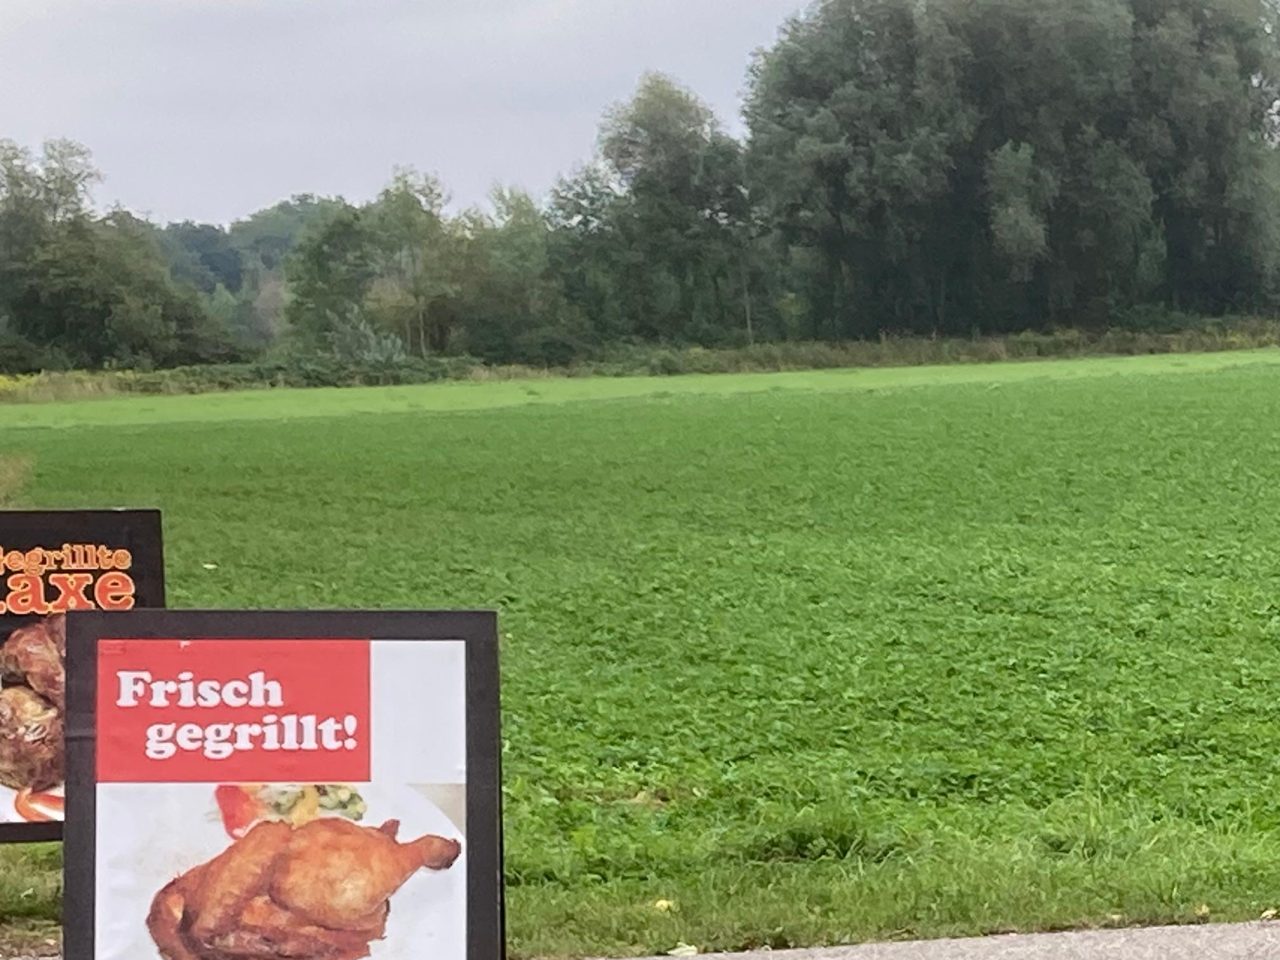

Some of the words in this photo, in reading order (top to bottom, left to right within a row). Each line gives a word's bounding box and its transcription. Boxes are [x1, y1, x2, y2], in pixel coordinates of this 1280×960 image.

[0, 571, 136, 615] axe
[116, 670, 284, 708] Frisch
[145, 714, 358, 760] gegrillt!
